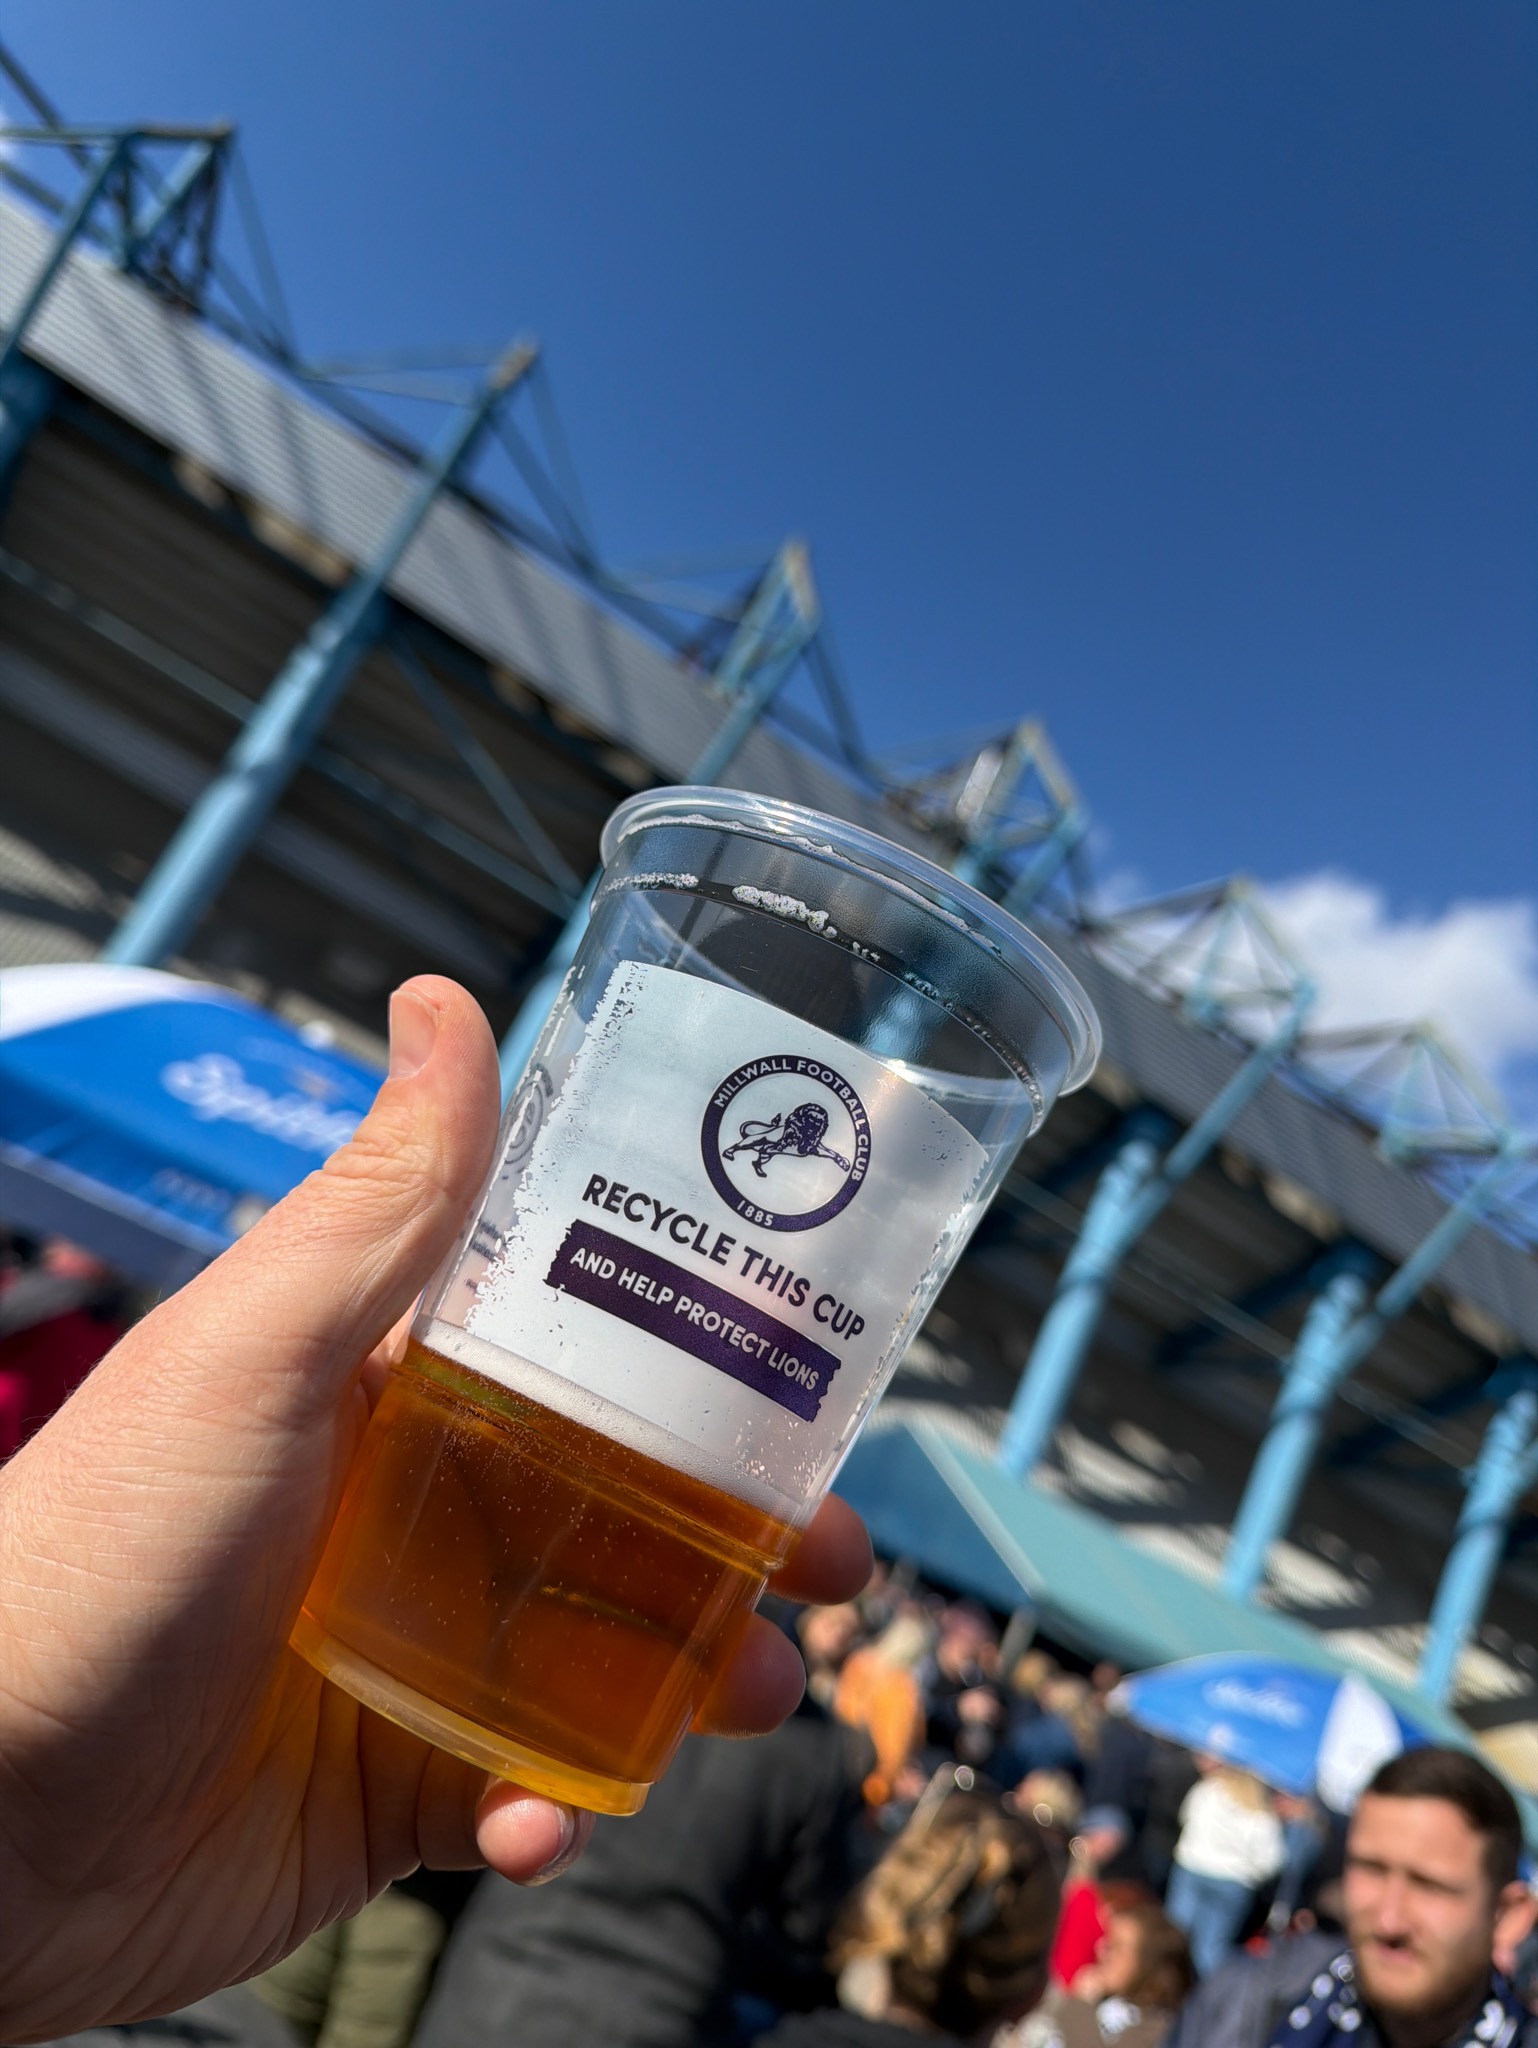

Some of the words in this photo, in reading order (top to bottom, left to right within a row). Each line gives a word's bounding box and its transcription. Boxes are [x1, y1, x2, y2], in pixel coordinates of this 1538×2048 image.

[714, 1058, 791, 1107] MILLWALL
[796, 1060, 865, 1130] FOOTBALL
[851, 1134, 868, 1181] CLUB
[581, 1173, 737, 1266] RECYCLE
[740, 1246, 811, 1307] THIS
[813, 1294, 866, 1341] CUP
[737, 1200, 774, 1226] 1885
[569, 1247, 616, 1280] AND
[617, 1266, 674, 1305] HELP
[673, 1296, 771, 1364] PROTECT
[768, 1345, 821, 1391] LIONS
